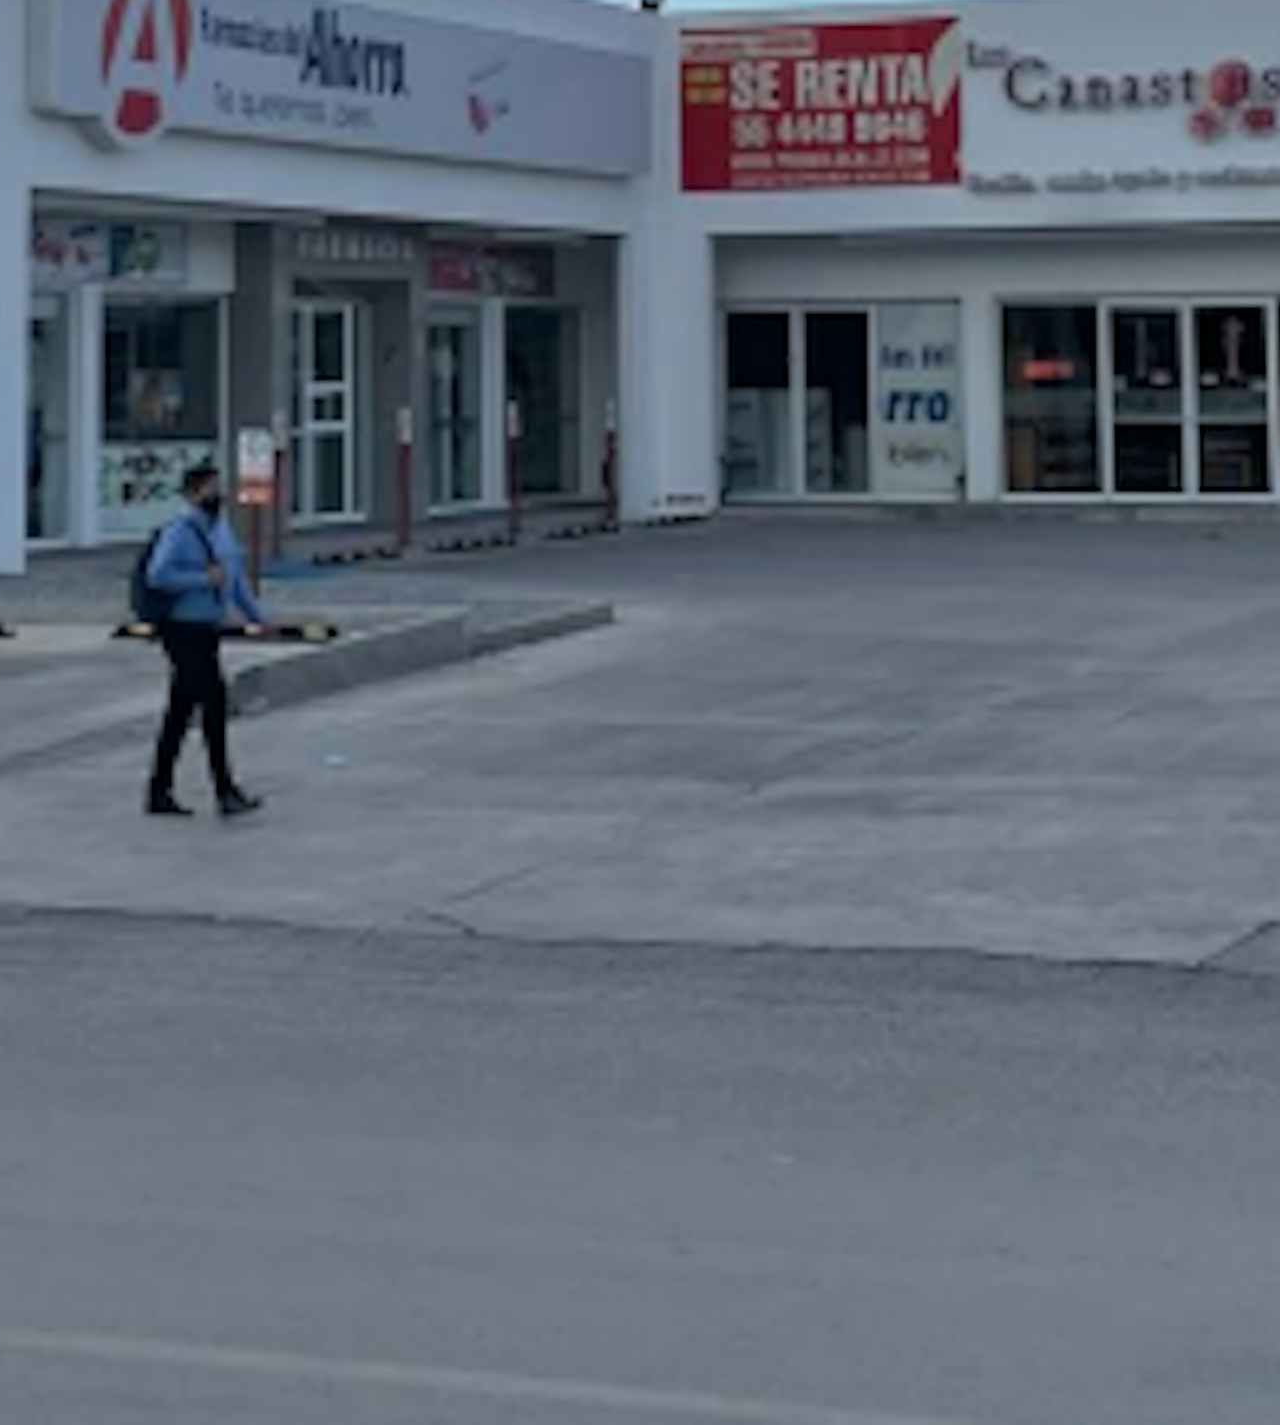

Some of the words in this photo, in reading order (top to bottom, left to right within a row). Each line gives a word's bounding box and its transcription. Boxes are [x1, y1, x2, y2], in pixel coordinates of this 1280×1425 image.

[299, 7, 405, 97] Ahorro
[731, 58, 781, 110] SE
[794, 52, 927, 107] RENTA
